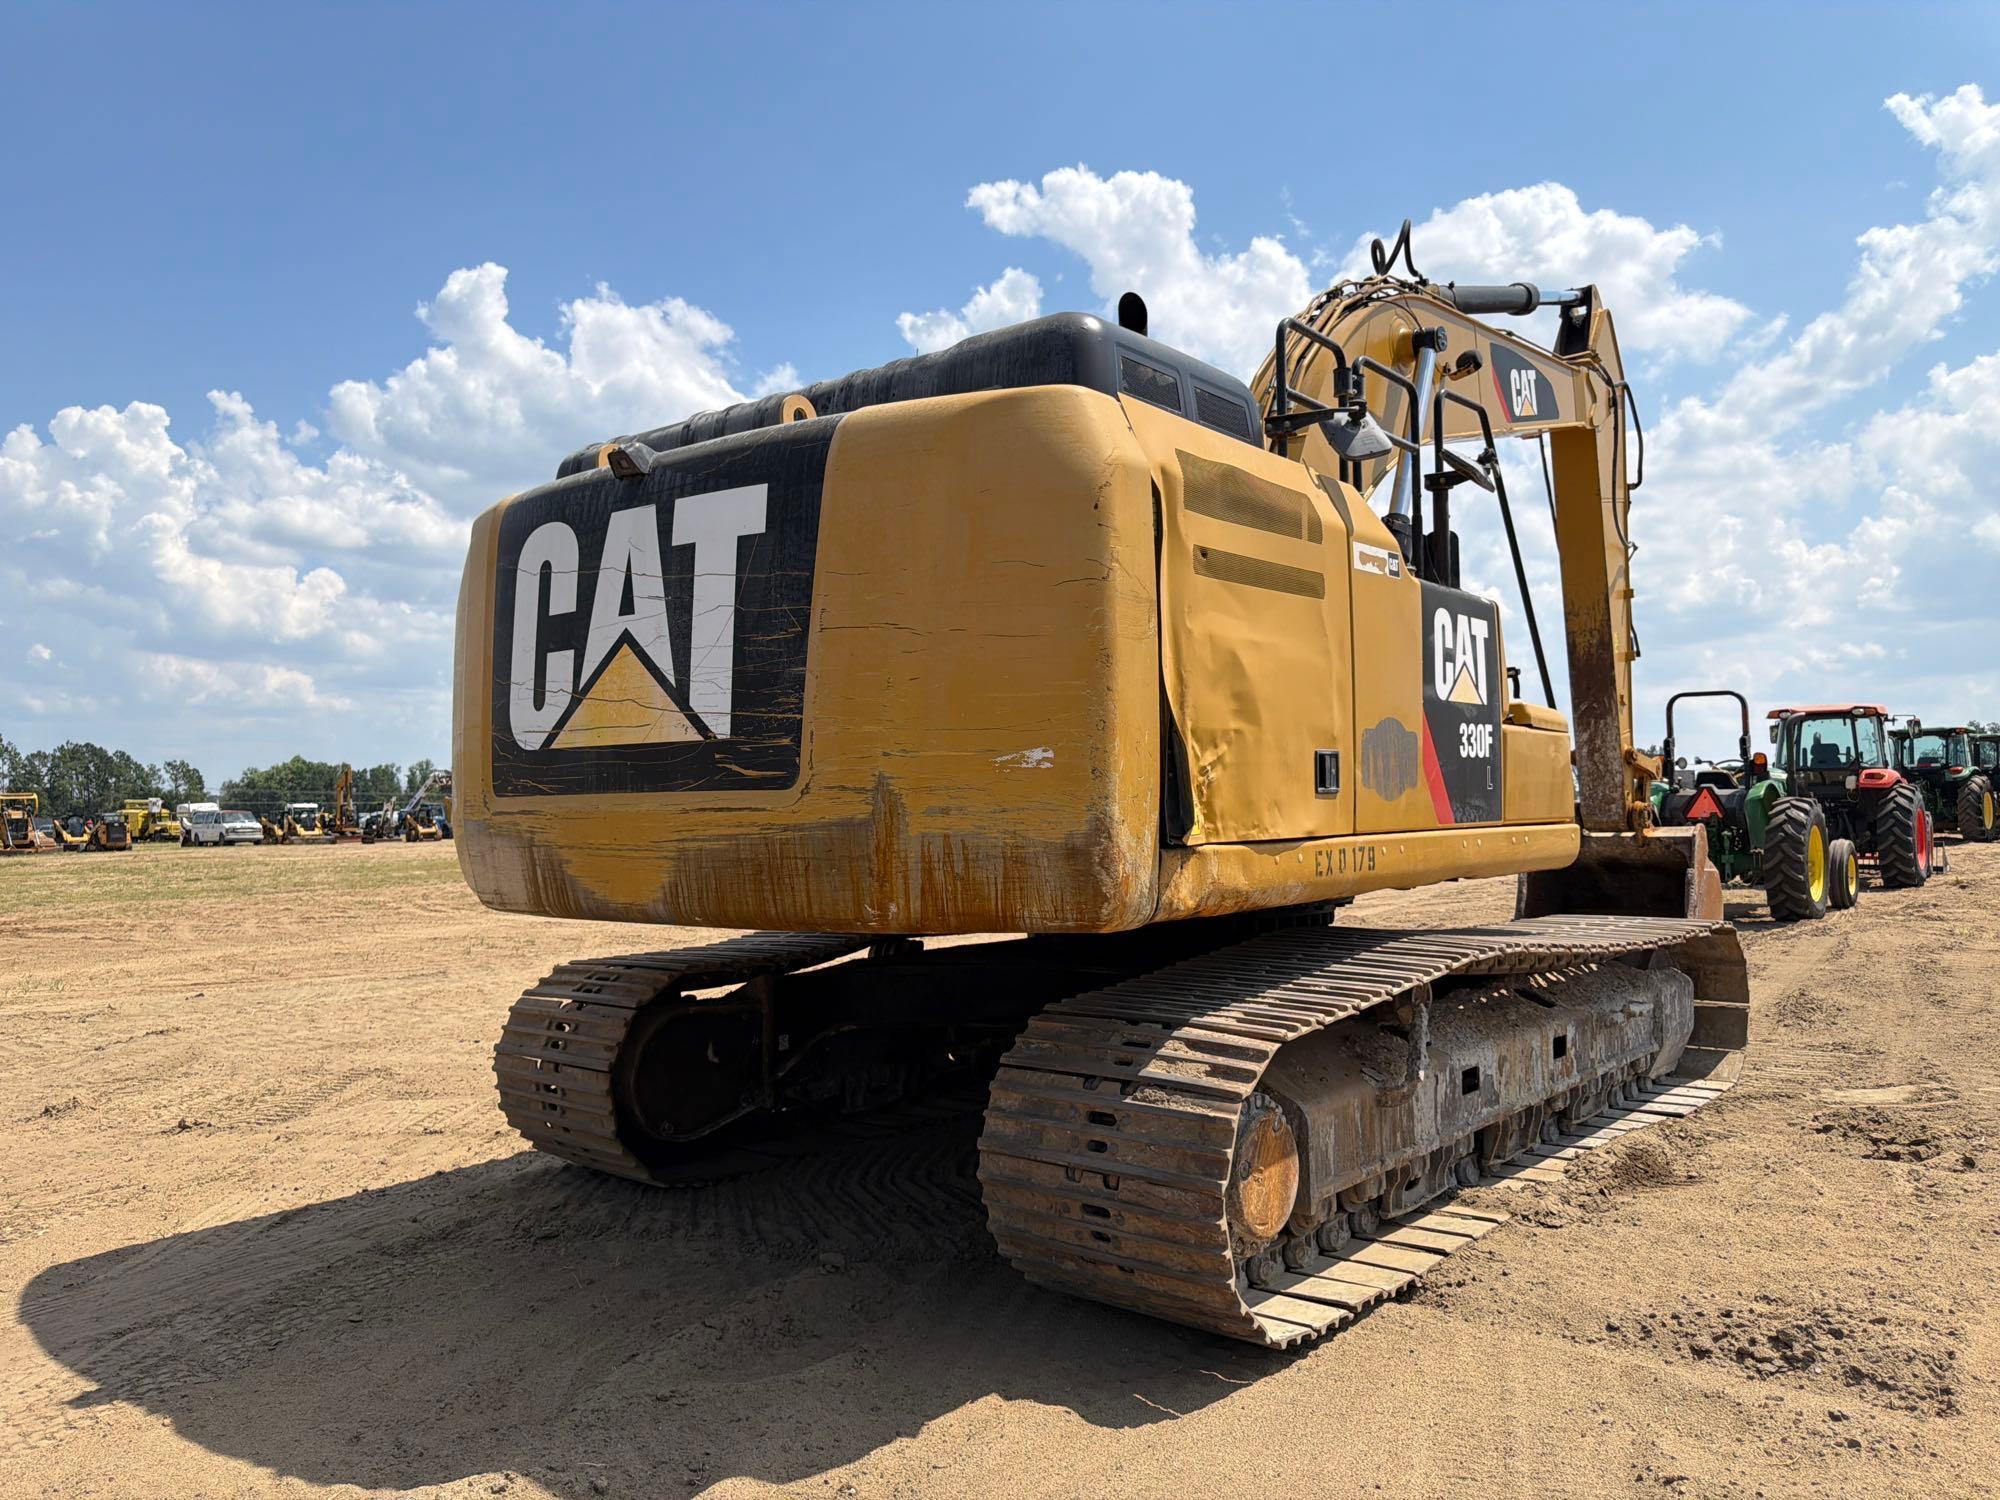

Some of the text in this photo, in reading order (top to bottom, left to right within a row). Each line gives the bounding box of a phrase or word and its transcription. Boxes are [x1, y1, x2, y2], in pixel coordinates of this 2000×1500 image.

[1510, 368, 1537, 416] CAT
[1389, 557, 1399, 571] CAT
[509, 483, 768, 750] CAT
[1434, 607, 1489, 705] CAT
[1459, 723, 1493, 758] 330F
[1486, 765, 1494, 790] L
